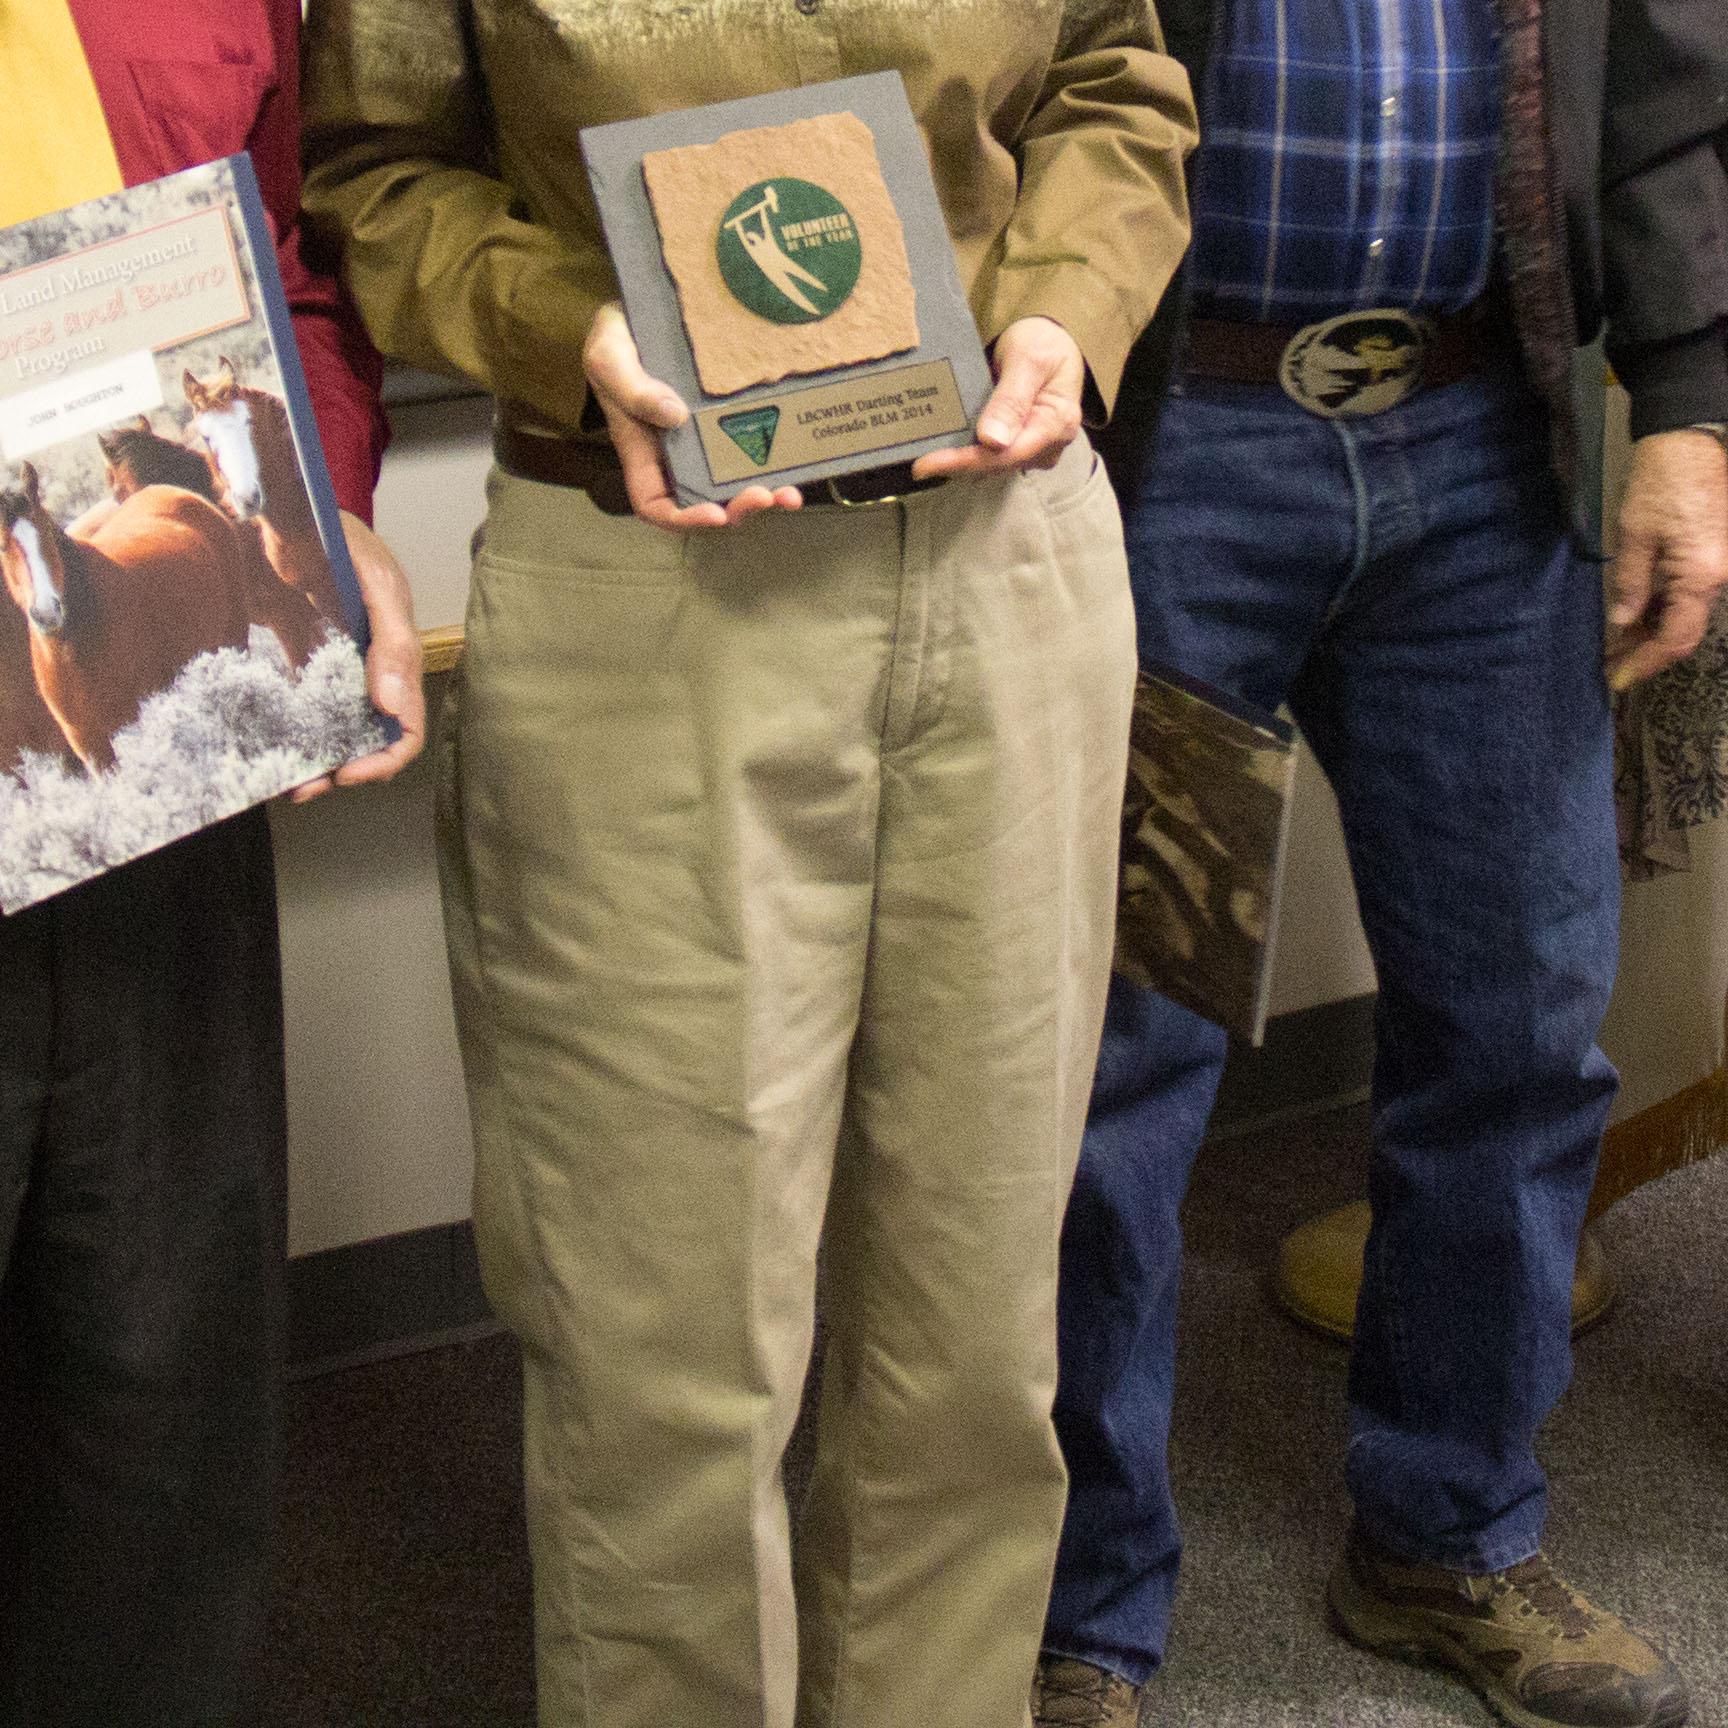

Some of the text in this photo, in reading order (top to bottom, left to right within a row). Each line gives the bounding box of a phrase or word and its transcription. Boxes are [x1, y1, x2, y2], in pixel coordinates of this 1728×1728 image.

[781, 213, 850, 241] VOLUNTEER
[786, 228, 853, 251] OF THE YEAR
[1, 277, 56, 315] Land
[60, 234, 196, 295] Management
[63, 287, 127, 333] and
[131, 263, 226, 312] Burro
[15, 334, 105, 379] Program
[904, 386, 938, 400] Team
[812, 403, 933, 440] Colorado BLM 2014
